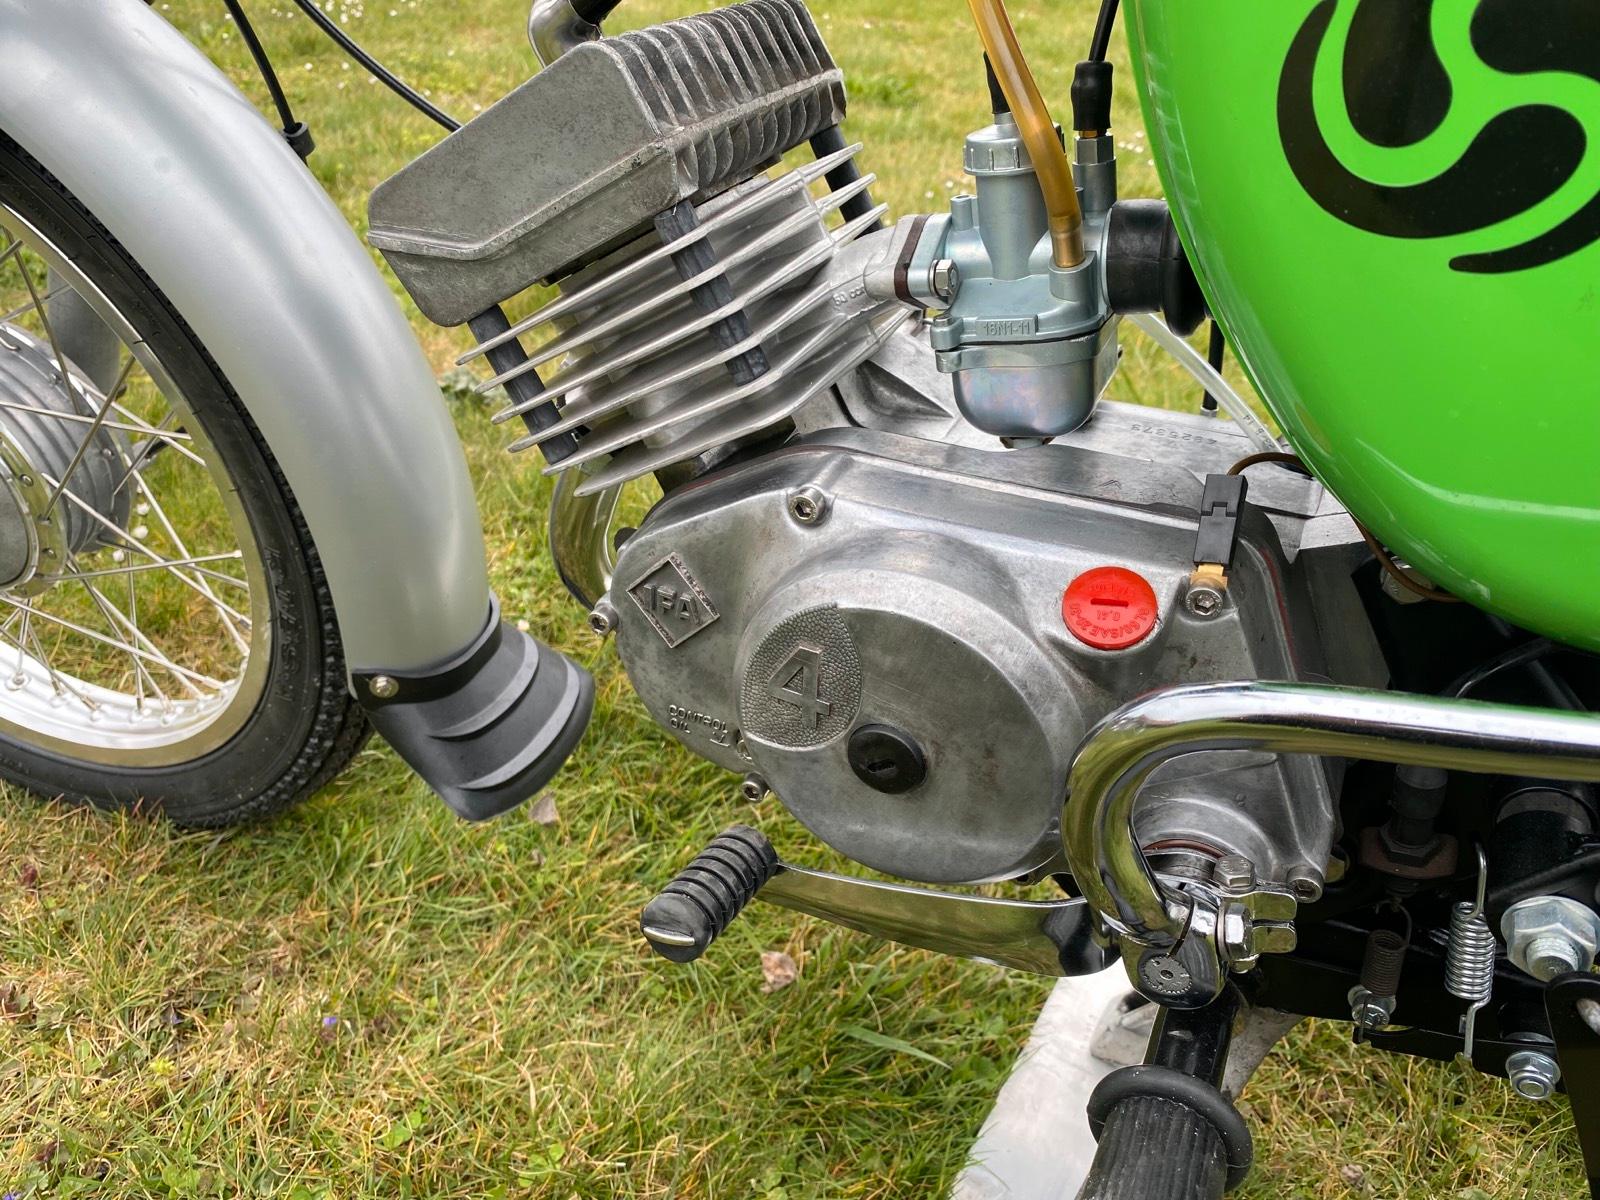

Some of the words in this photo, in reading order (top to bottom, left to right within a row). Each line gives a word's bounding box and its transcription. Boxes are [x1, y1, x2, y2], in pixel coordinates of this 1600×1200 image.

[643, 583, 700, 626] IFA
[767, 641, 831, 728] 4
[667, 704, 729, 734] CONTROL
[669, 717, 691, 735] OIL
